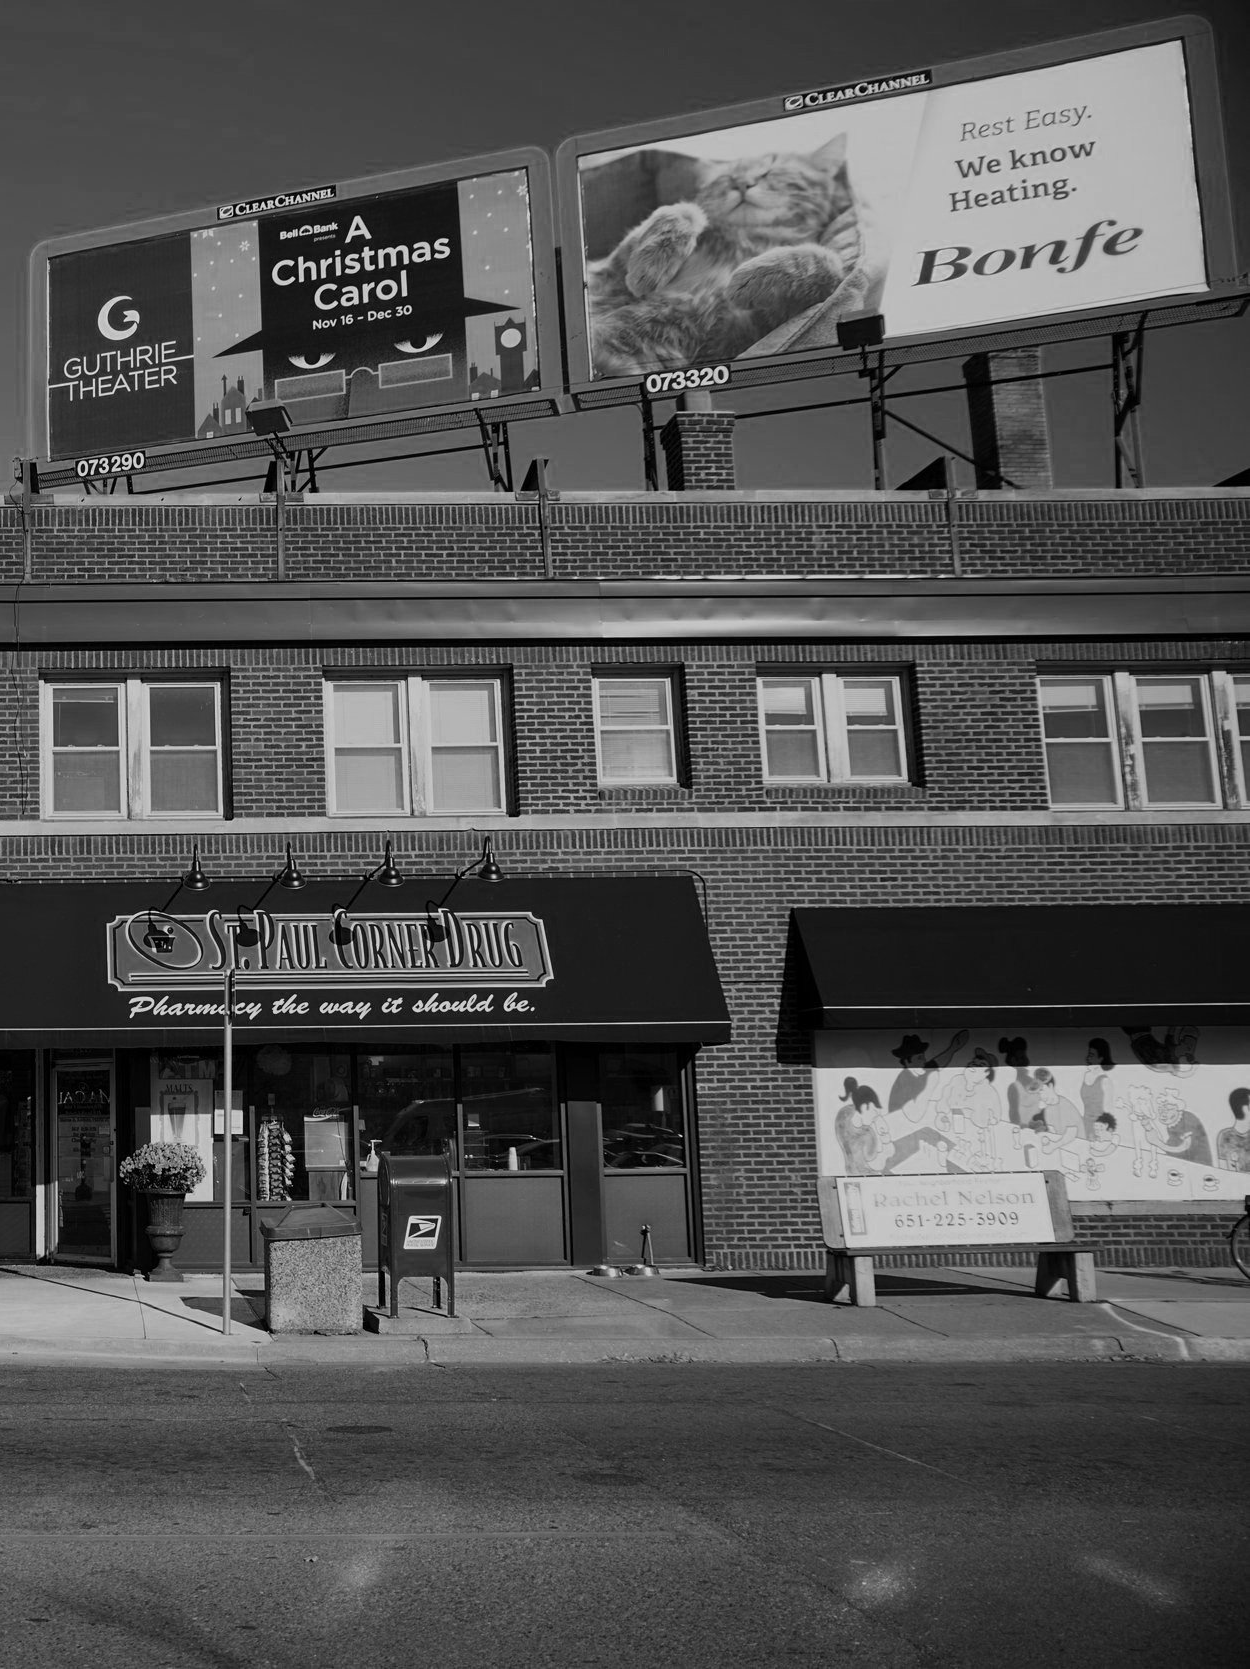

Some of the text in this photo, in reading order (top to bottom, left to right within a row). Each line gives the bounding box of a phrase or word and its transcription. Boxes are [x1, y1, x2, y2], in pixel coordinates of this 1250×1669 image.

[959, 103, 1092, 143] Rest Easy.
[954, 140, 1096, 179] We know
[948, 175, 1078, 213] Heating.
[279, 221, 339, 241] Bell Bank
[313, 233, 336, 242] presents
[344, 214, 373, 244] A
[271, 236, 451, 287] Christmas
[911, 219, 1144, 287] Bonfe
[313, 269, 408, 311] Carol
[312, 318, 338, 331] Nov
[340, 313, 354, 326] 16
[367, 309, 392, 322] Dec
[395, 304, 413, 317] 30
[63, 340, 177, 379] GUTHRIE
[64, 365, 178, 402] THEATER
[645, 365, 730, 393] 073320
[76, 451, 145, 477] 073290
[253, 909, 328, 970] PAUL
[438, 908, 524, 969] DRUG
[271, 993, 311, 1015] the
[319, 997, 372, 1020] way
[381, 997, 404, 1014] it
[412, 992, 495, 1014] should
[503, 991, 536, 1013] be.
[873, 1189, 1036, 1208] Rachel Nelson
[894, 1210, 1020, 1229] 651-225-3909
